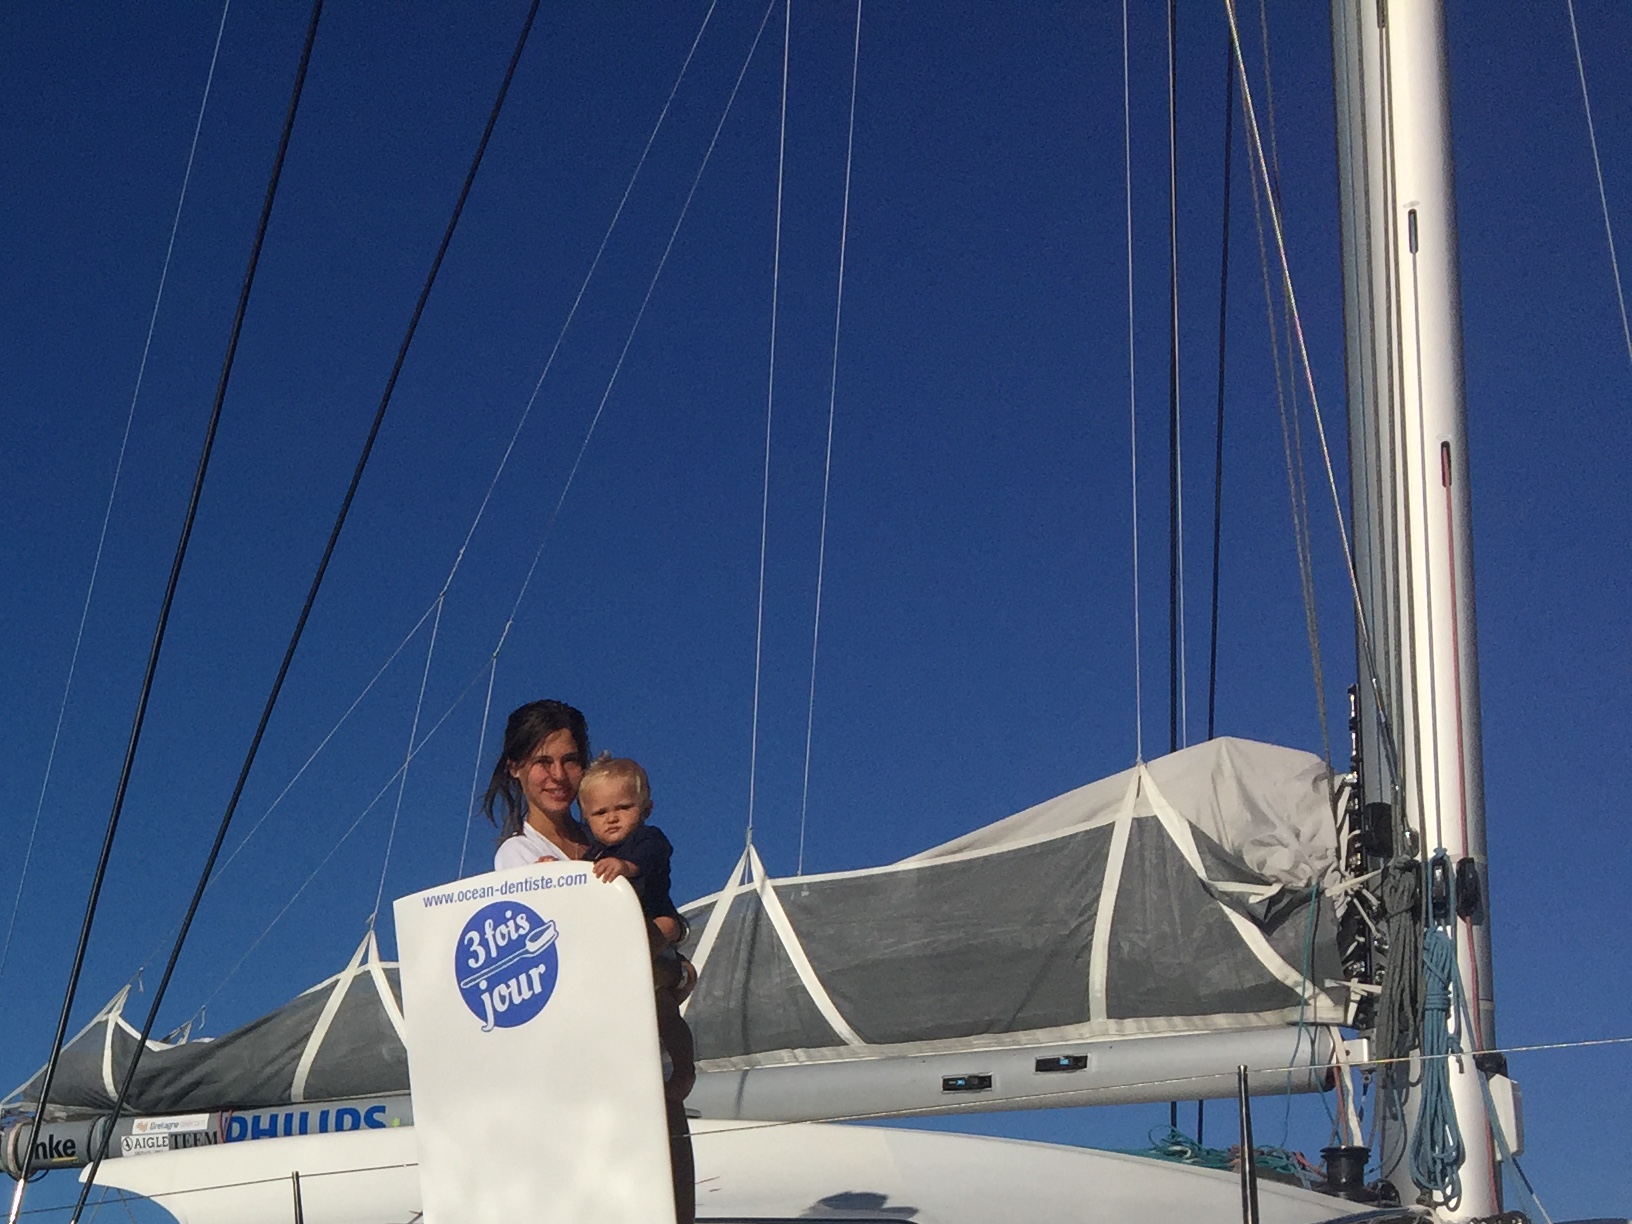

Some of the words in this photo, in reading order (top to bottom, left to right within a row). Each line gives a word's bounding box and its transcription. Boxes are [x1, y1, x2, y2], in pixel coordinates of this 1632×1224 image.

[422, 872, 588, 908] www.ocean-dentiste.com
[463, 930, 486, 969] 3
[484, 909, 530, 957] fois
[480, 963, 546, 1032] jour
[34, 1133, 77, 1160] nke
[134, 1136, 168, 1149] AIGLE
